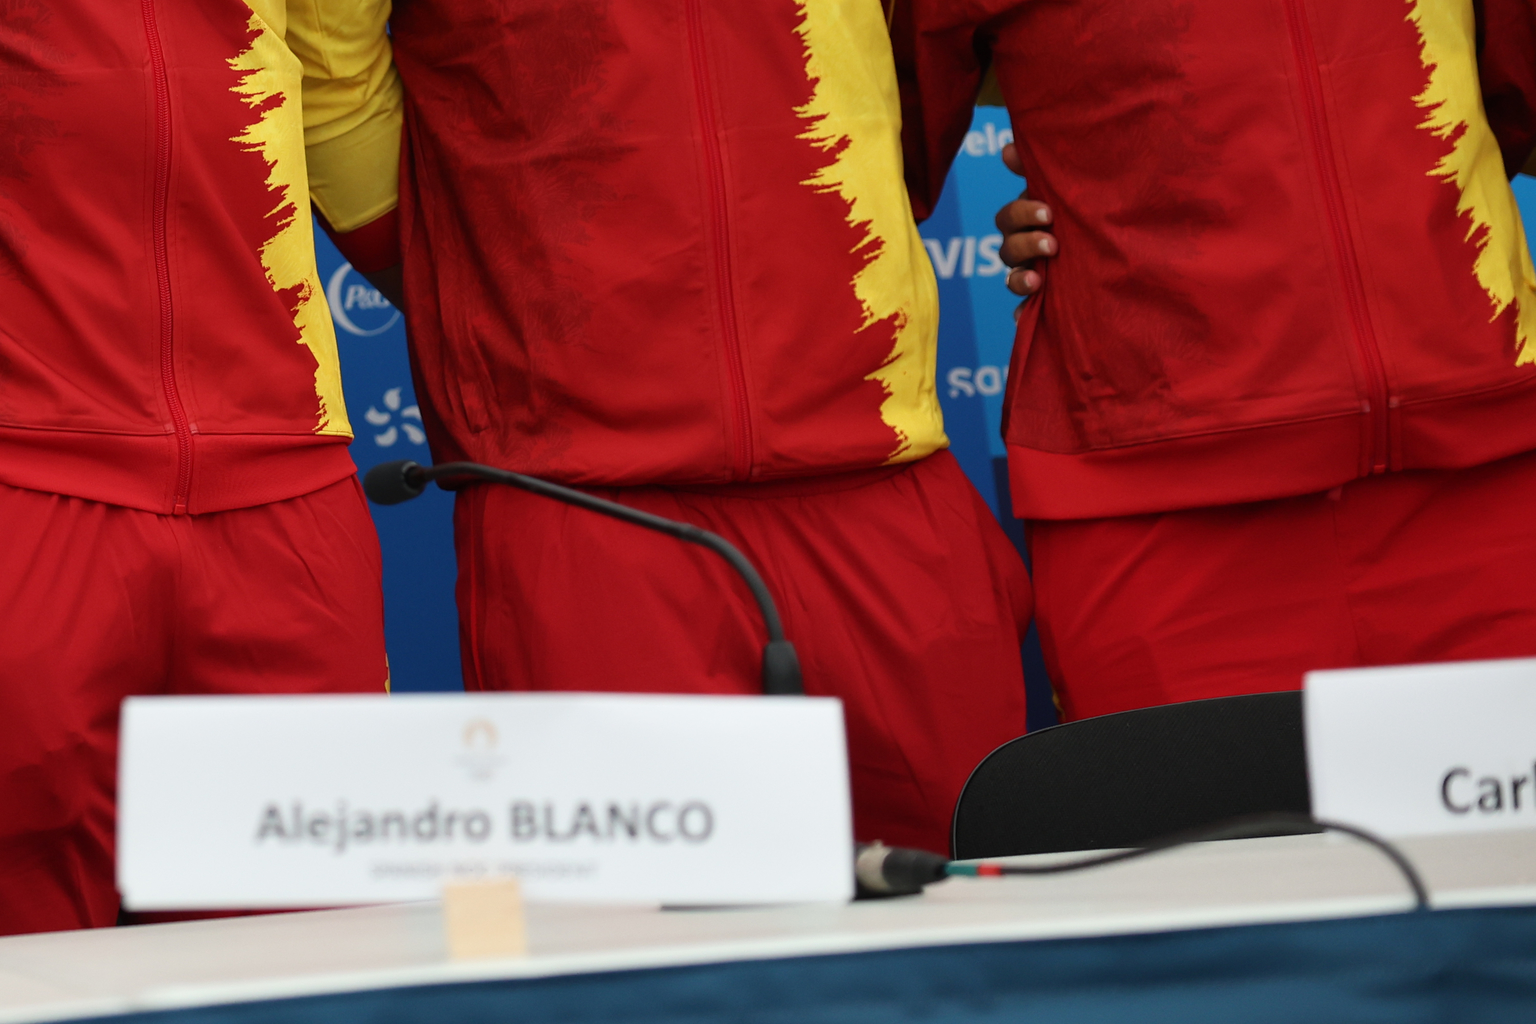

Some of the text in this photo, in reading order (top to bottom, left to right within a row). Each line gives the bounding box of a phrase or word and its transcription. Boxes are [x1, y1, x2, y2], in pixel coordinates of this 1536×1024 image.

[923, 235, 1010, 279] VIS
[256, 799, 715, 855] Alejandro BLANCO
